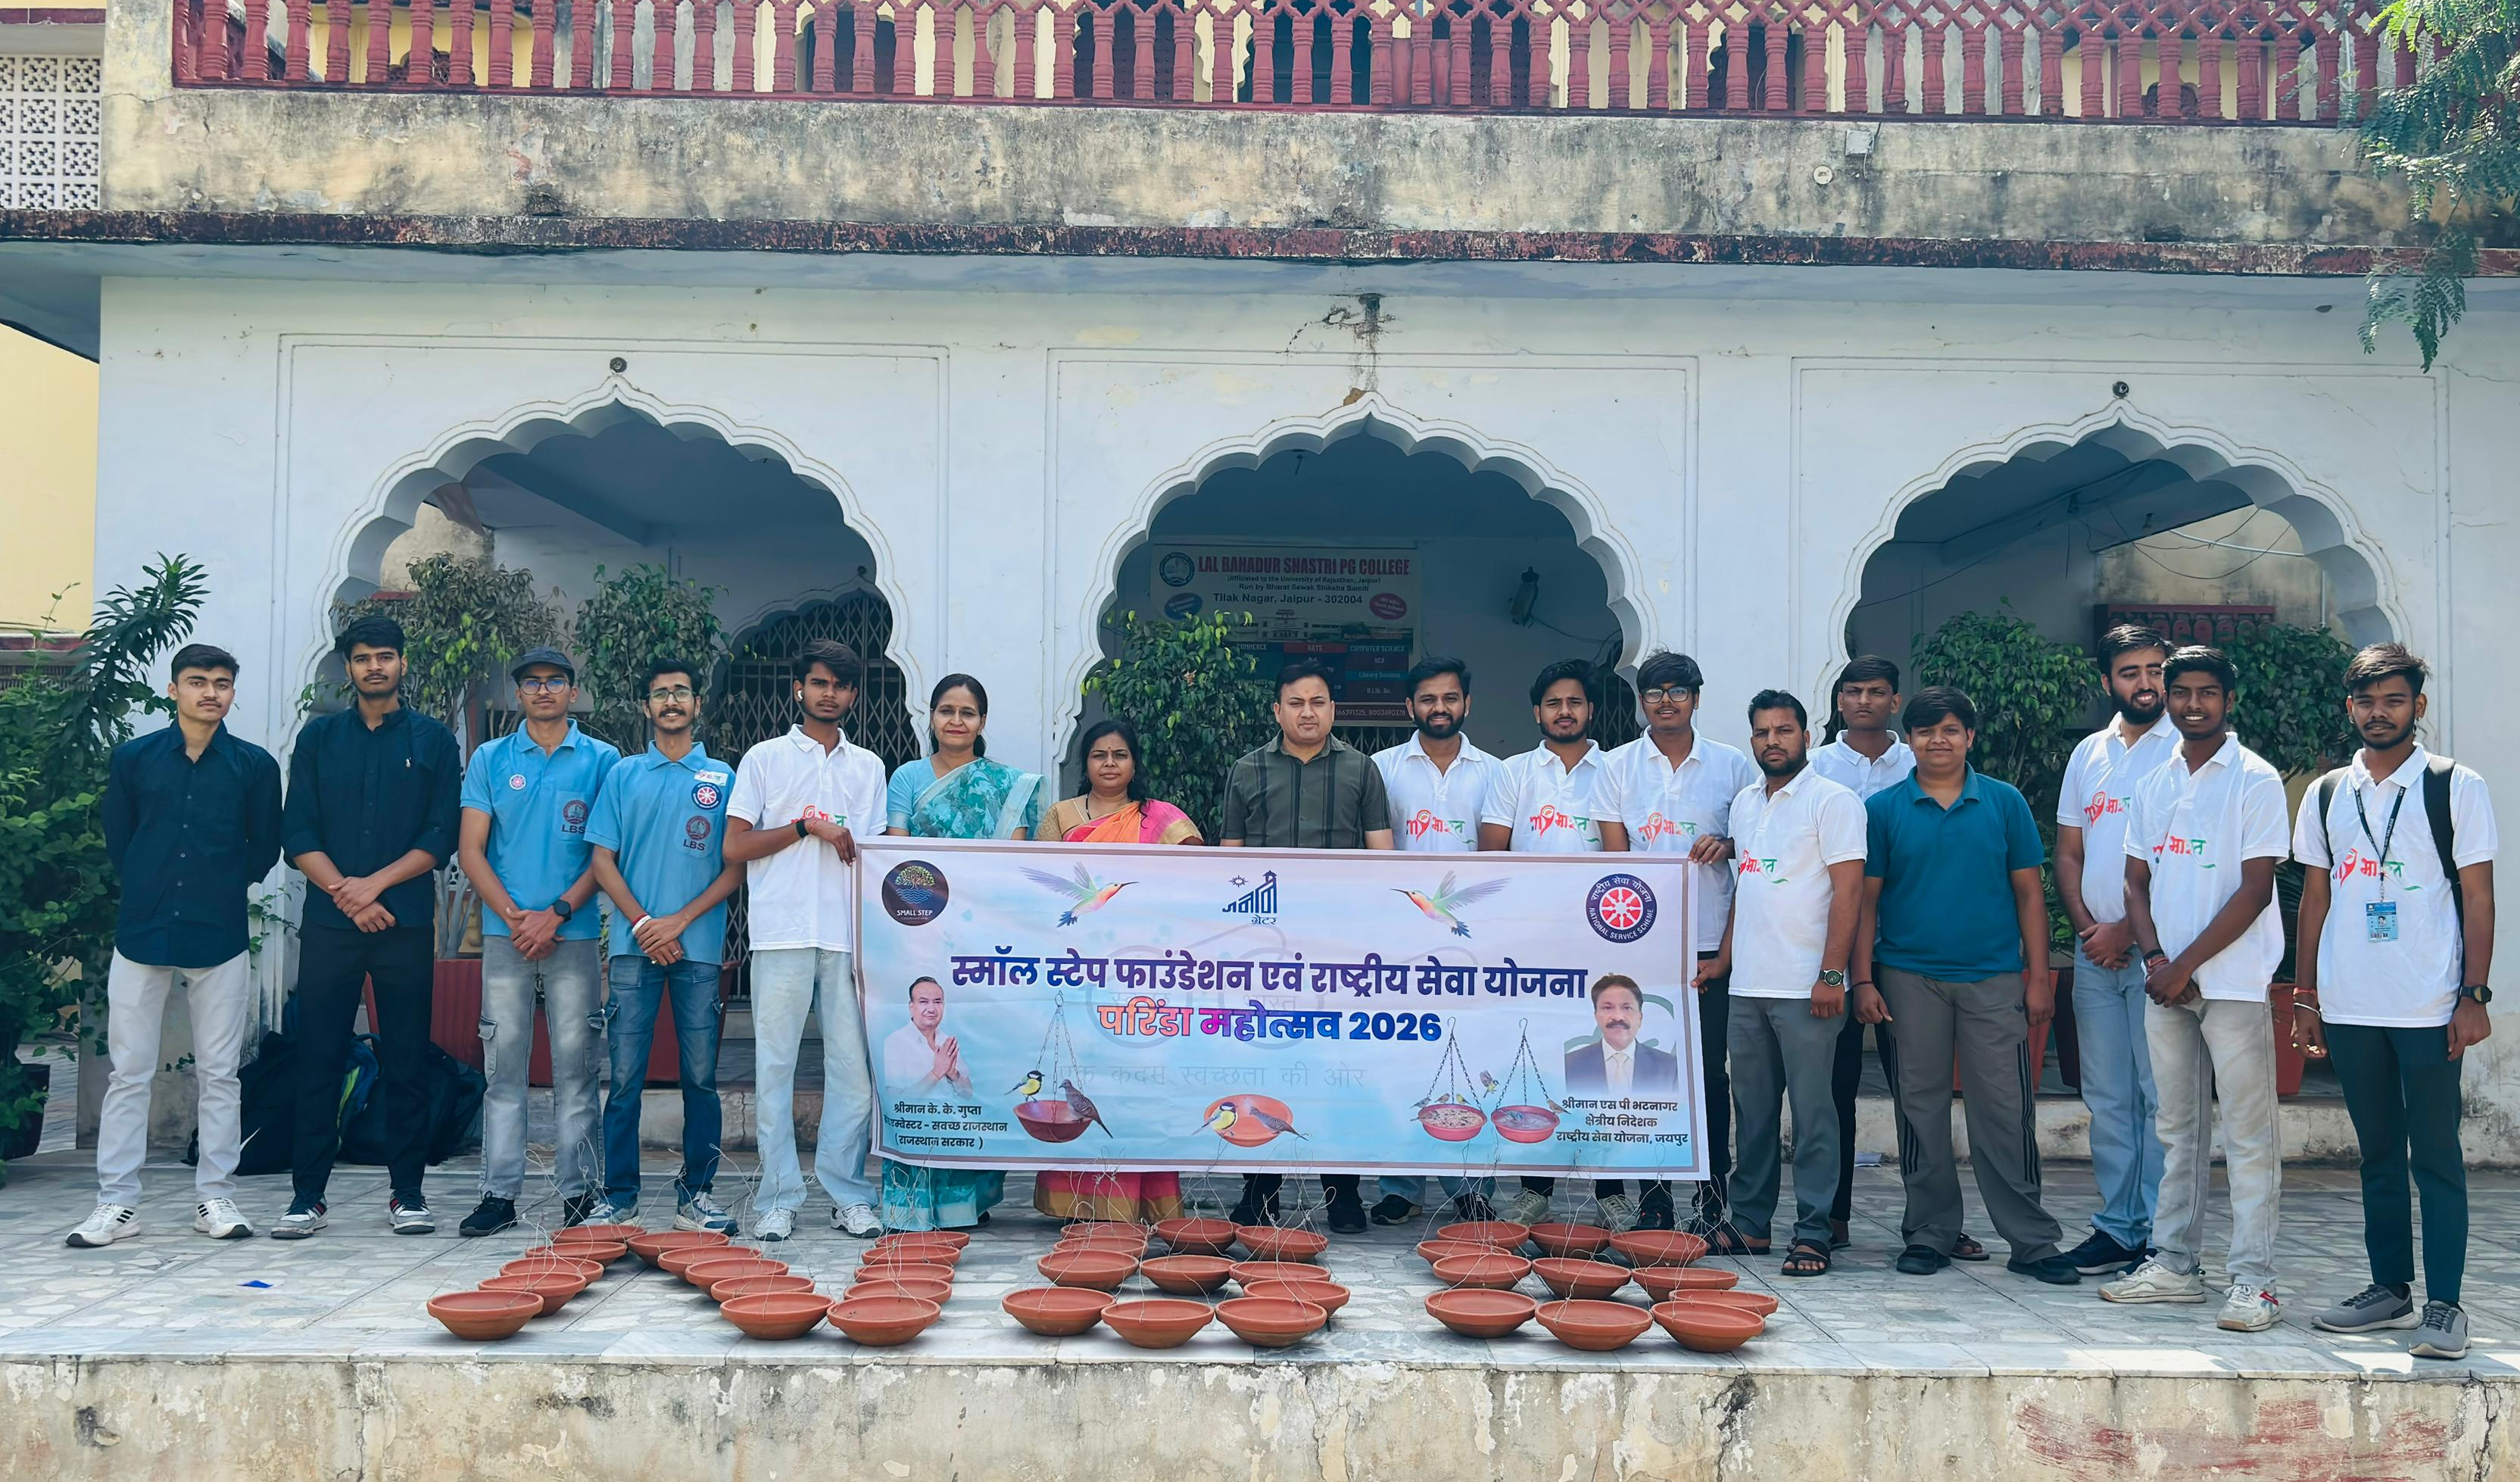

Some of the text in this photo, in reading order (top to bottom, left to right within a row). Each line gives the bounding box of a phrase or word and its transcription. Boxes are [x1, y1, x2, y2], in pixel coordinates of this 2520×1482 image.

[1198, 556, 1218, 573] LAL
[1221, 557, 1281, 574] BAHADUR
[1283, 557, 1337, 575] SHASTRI
[1340, 558, 1357, 576] PG
[1358, 559, 1411, 576] COLLEGE
[1255, 583, 1264, 591] by
[1280, 576, 1313, 584] University
[1212, 593, 1239, 602] Tilak
[1242, 594, 1277, 604] Nagar,
[1280, 594, 1315, 605] Jaipur
[1324, 595, 1363, 604] 302004
[1237, 643, 1268, 651] COMMERCE
[561, 824, 586, 834] LBS
[683, 838, 706, 851] LBS
[1590, 875, 1653, 903] राष्ट्रीय सेवा योजना
[1589, 906, 1655, 941] NATIONAL SERVICE SCHEME
[951, 945, 1589, 999] स्मॉल स्टेप फाउंडेशन एवं राष्ट्रीय सेवा योजना
[1096, 995, 1442, 1042] परिंडा महोत्सव 2026
[1280, 1061, 1311, 1087] की
[1324, 1061, 1368, 1088] ओर
[894, 1101, 982, 1118] श्रीमान के. के. गुप्ता
[1561, 1097, 1679, 1112] श्रीमान एस पी भटनागर
[962, 1122, 1009, 1132] राजस्थान
[1585, 1113, 1658, 1128] क्षेत्रीय निदेशक
[941, 1137, 975, 1147] सरकार
[1556, 1129, 1689, 1147] राष्ट्रीय सेवा योजना, जयपुर
